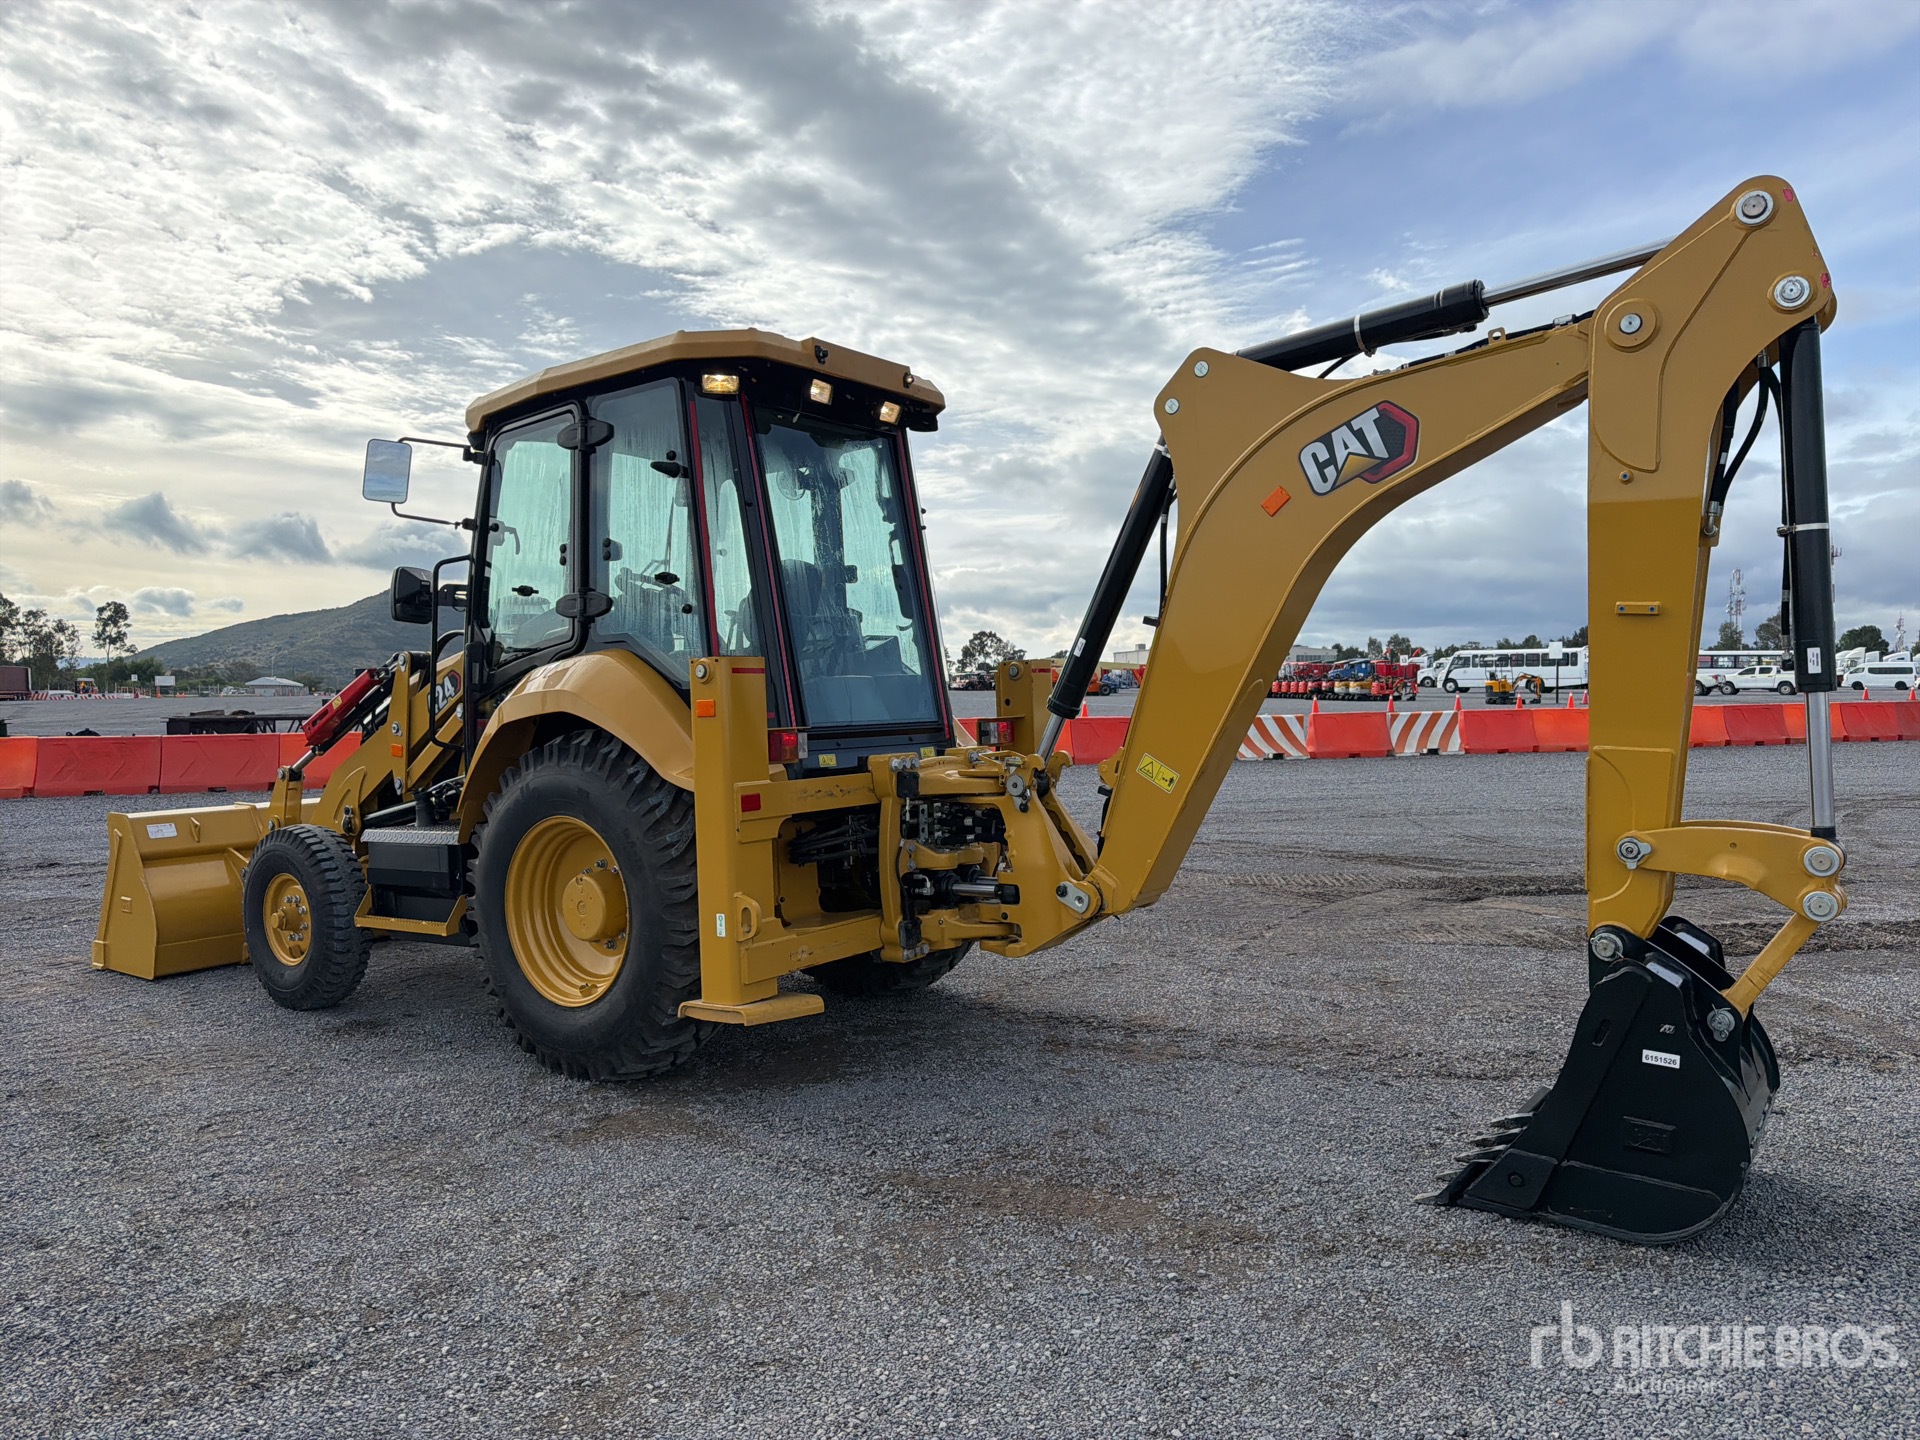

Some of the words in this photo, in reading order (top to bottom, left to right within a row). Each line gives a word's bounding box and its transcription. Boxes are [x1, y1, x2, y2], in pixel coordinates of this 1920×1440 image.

[1300, 407, 1389, 494] CAT
[428, 675, 455, 713] 24
[1644, 1053, 1677, 1066] 6151526
